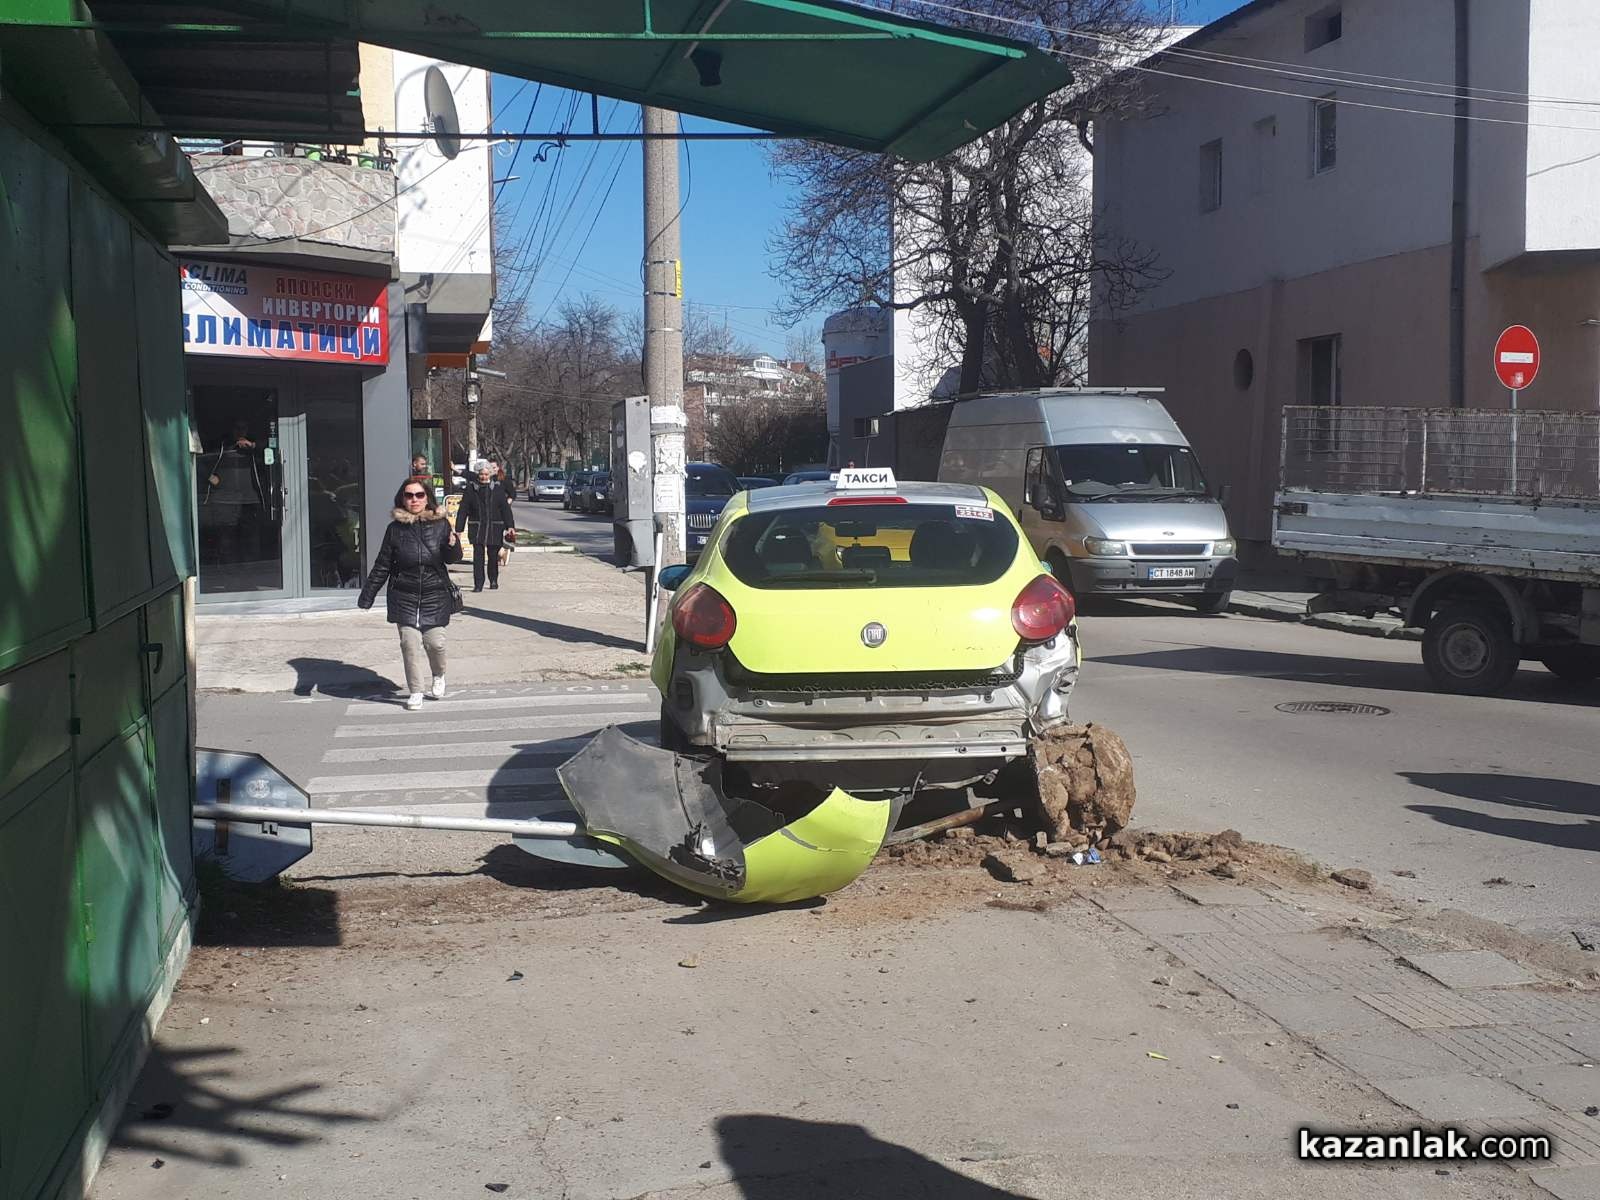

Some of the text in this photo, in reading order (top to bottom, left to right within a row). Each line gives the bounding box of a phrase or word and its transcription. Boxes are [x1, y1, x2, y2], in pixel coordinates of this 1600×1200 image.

[184, 282, 245, 294] CONDITIONING
[275, 277, 355, 299] ЯПОНСКИ
[262, 298, 380, 323] ИНВЕРТОРНИ
[844, 473, 888, 484] ТАКСИ
